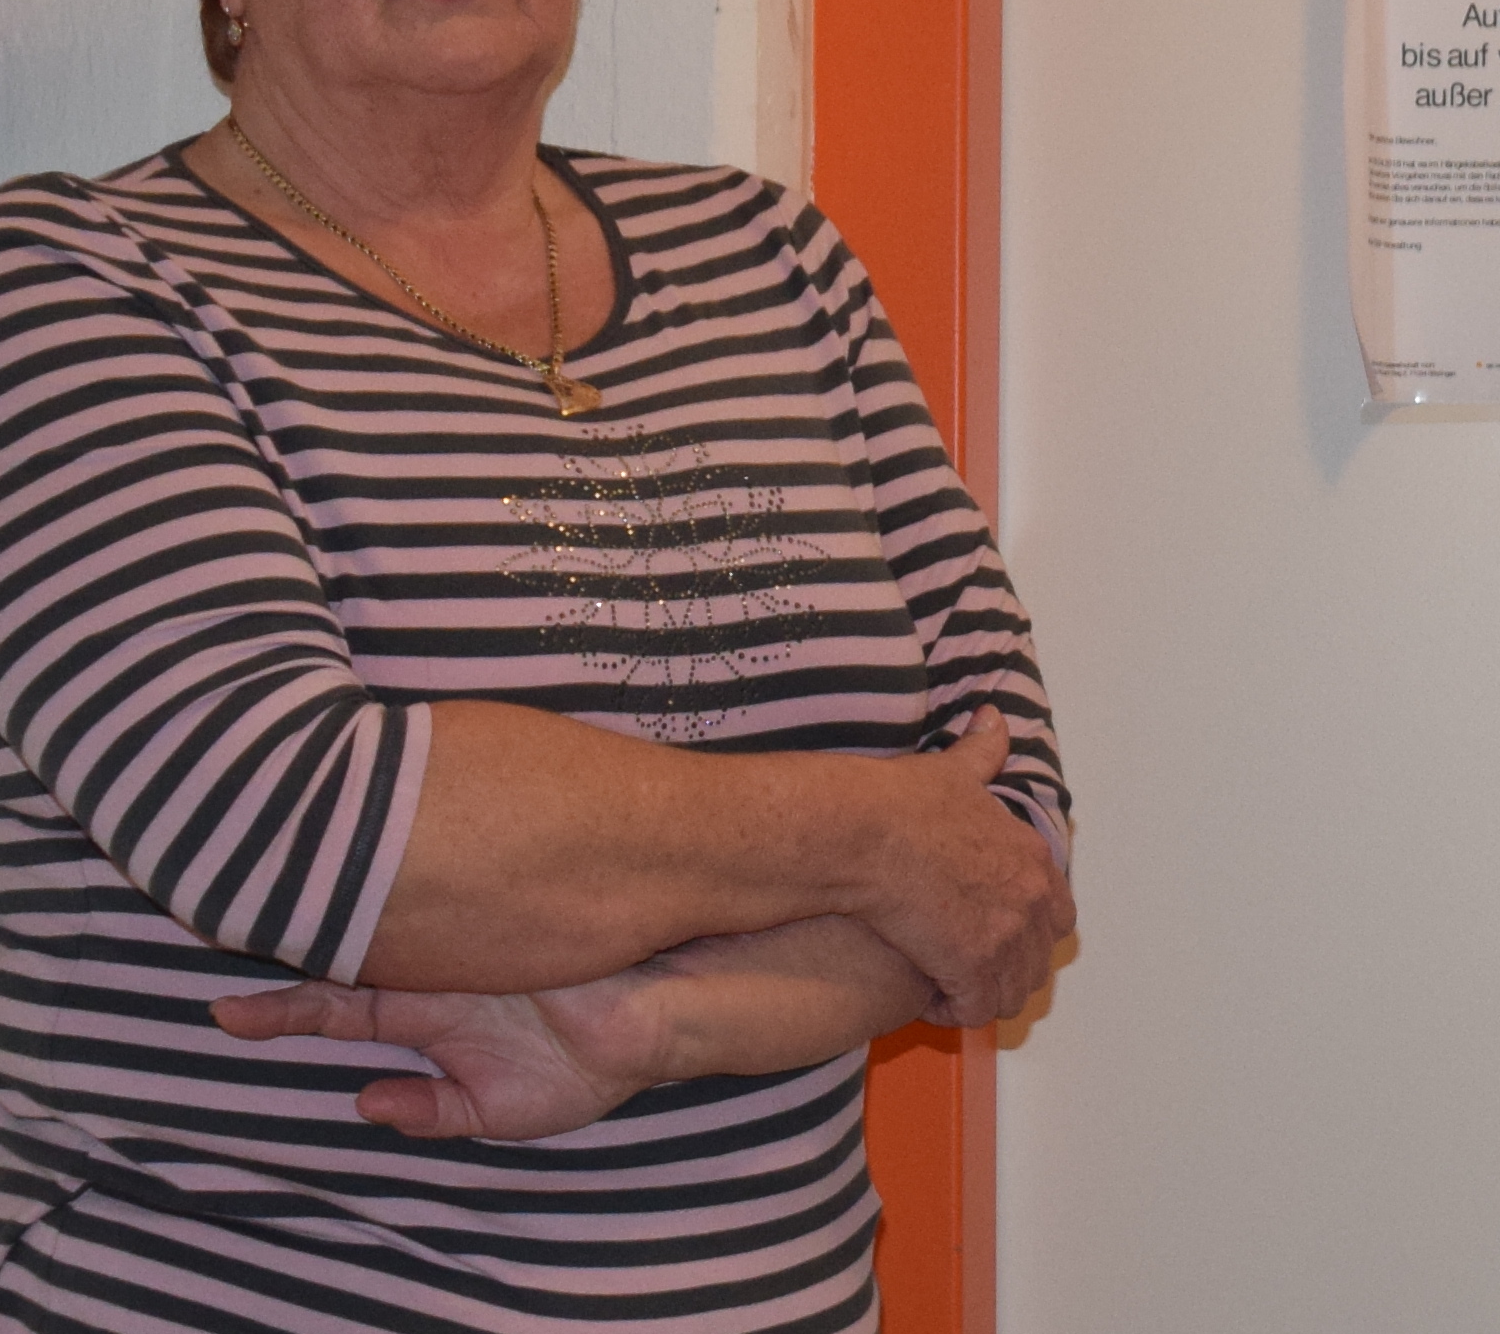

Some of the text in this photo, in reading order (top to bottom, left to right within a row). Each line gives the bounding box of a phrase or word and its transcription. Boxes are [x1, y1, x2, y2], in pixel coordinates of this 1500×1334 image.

[1400, 41, 1441, 68] bis
[1446, 41, 1489, 68] auf
[1414, 81, 1493, 108] außer
